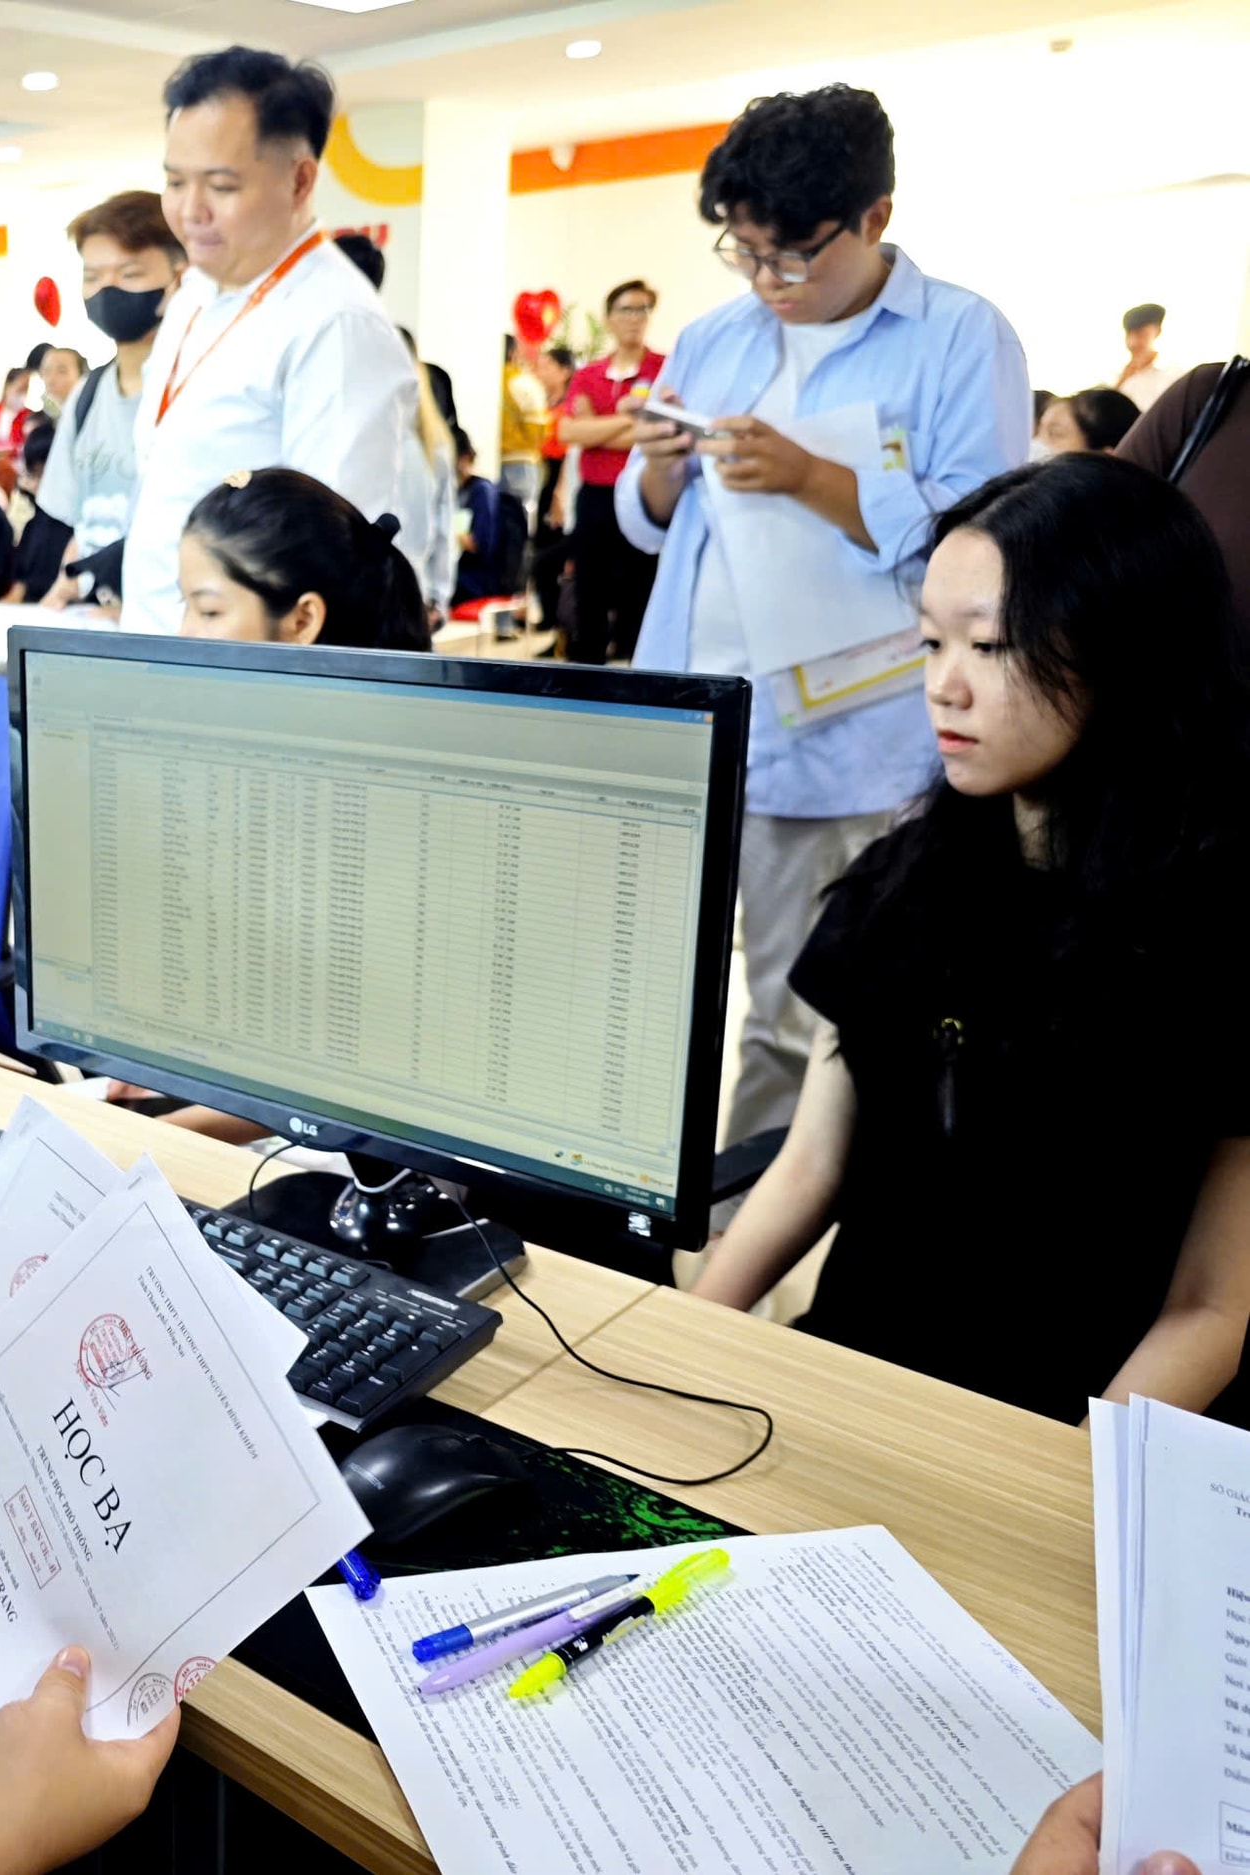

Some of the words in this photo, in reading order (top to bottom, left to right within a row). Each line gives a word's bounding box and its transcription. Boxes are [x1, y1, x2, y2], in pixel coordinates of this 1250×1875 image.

[301, 1122, 319, 1136] LG
[36, 1444, 56, 1479] TRUNG
[51, 1398, 106, 1486] HỌC
[92, 1485, 132, 1554] BẠ
